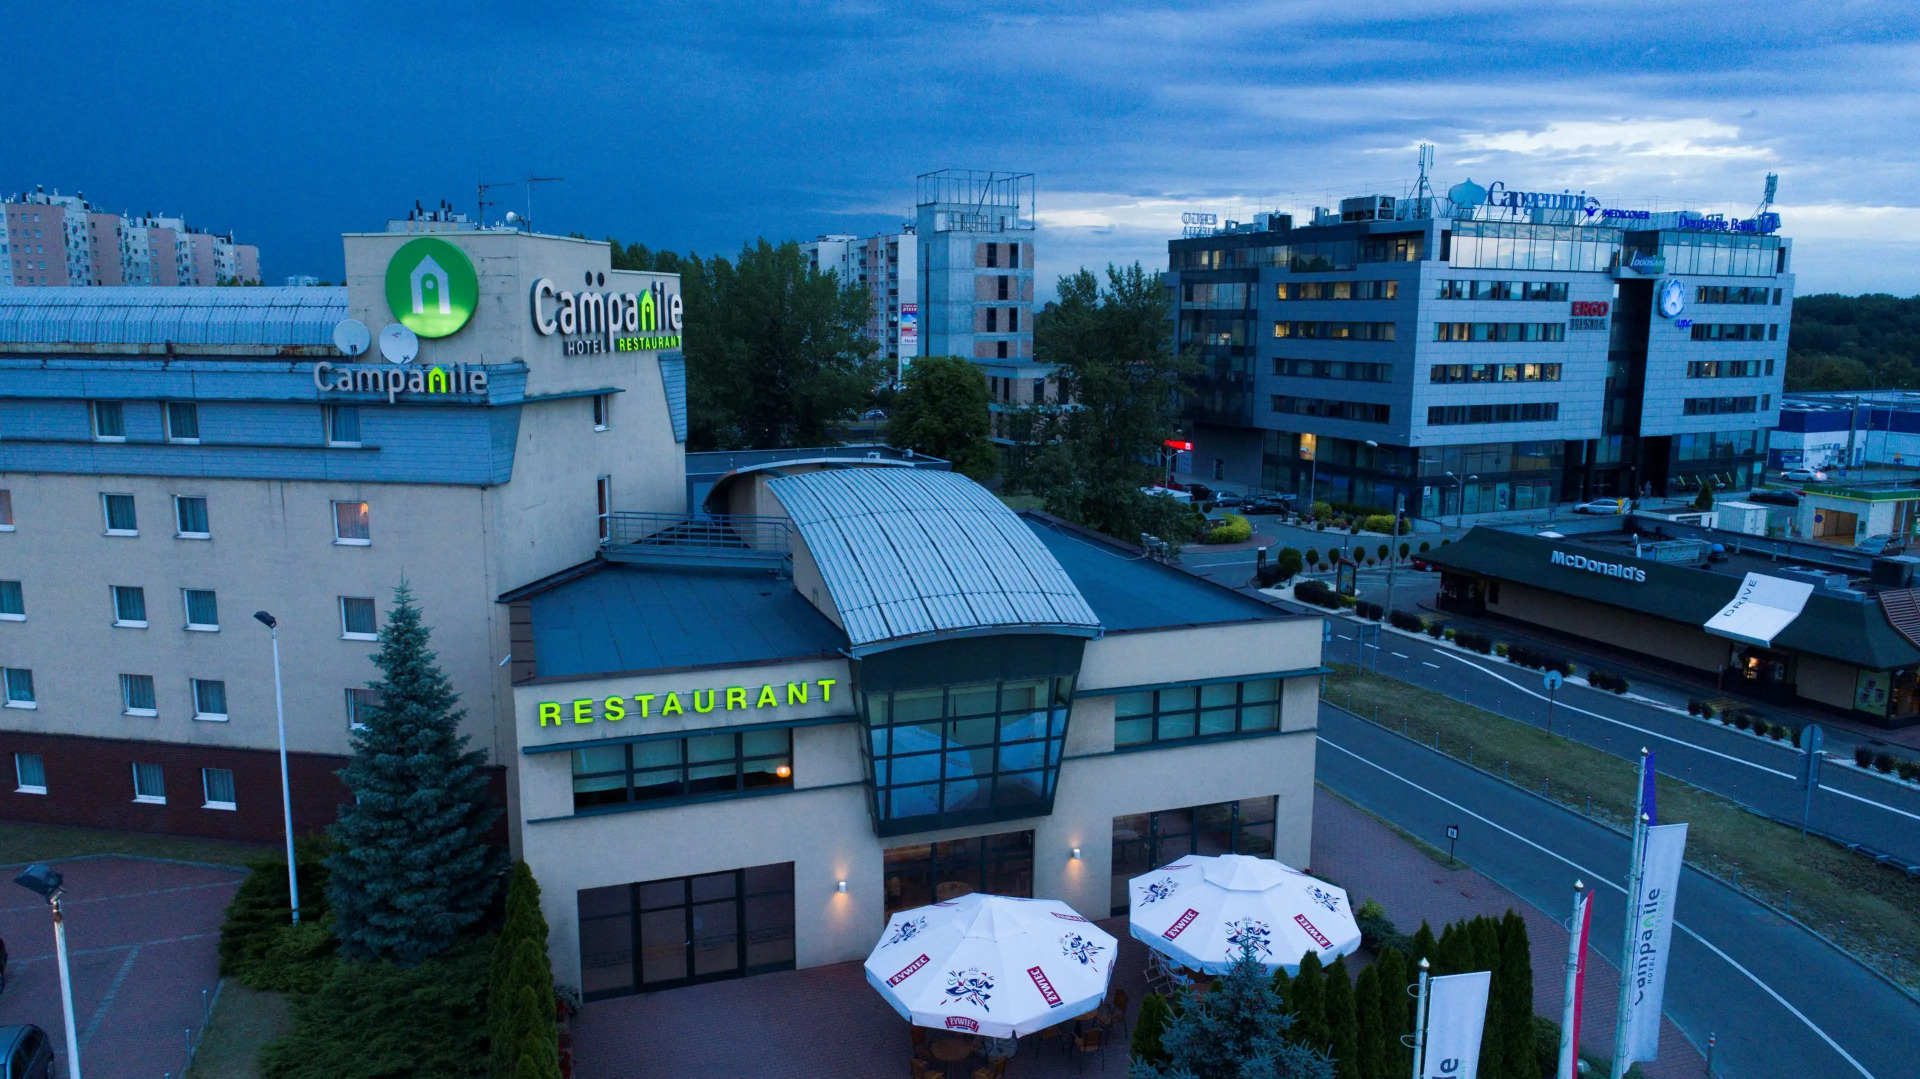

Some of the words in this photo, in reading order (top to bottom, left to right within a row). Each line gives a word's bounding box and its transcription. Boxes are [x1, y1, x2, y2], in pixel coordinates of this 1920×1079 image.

[1488, 181, 1586, 216] Capgemini
[1602, 209, 1650, 220] MEDICOVER
[1679, 214, 1729, 230] Deutsche
[1731, 218, 1757, 231] Bank
[1633, 258, 1664, 267] DOOSAN
[531, 275, 683, 353] Campanile
[1571, 300, 1609, 316] ERGO
[1675, 319, 1693, 330] upc
[566, 340, 606, 355] HOTEL
[617, 335, 682, 352] RESTAURANT
[313, 361, 488, 404] Campanile
[1551, 550, 1646, 583] McDonald's
[1723, 579, 1758, 617] DRIVE
[539, 678, 836, 727] RESTAURANT
[891, 955, 929, 984] ŻYWIEC
[1646, 956, 1657, 984] HOTEL
[1030, 967, 1059, 1002] ŻYWIEC
[948, 1015, 977, 1029] ŻYWIEC
